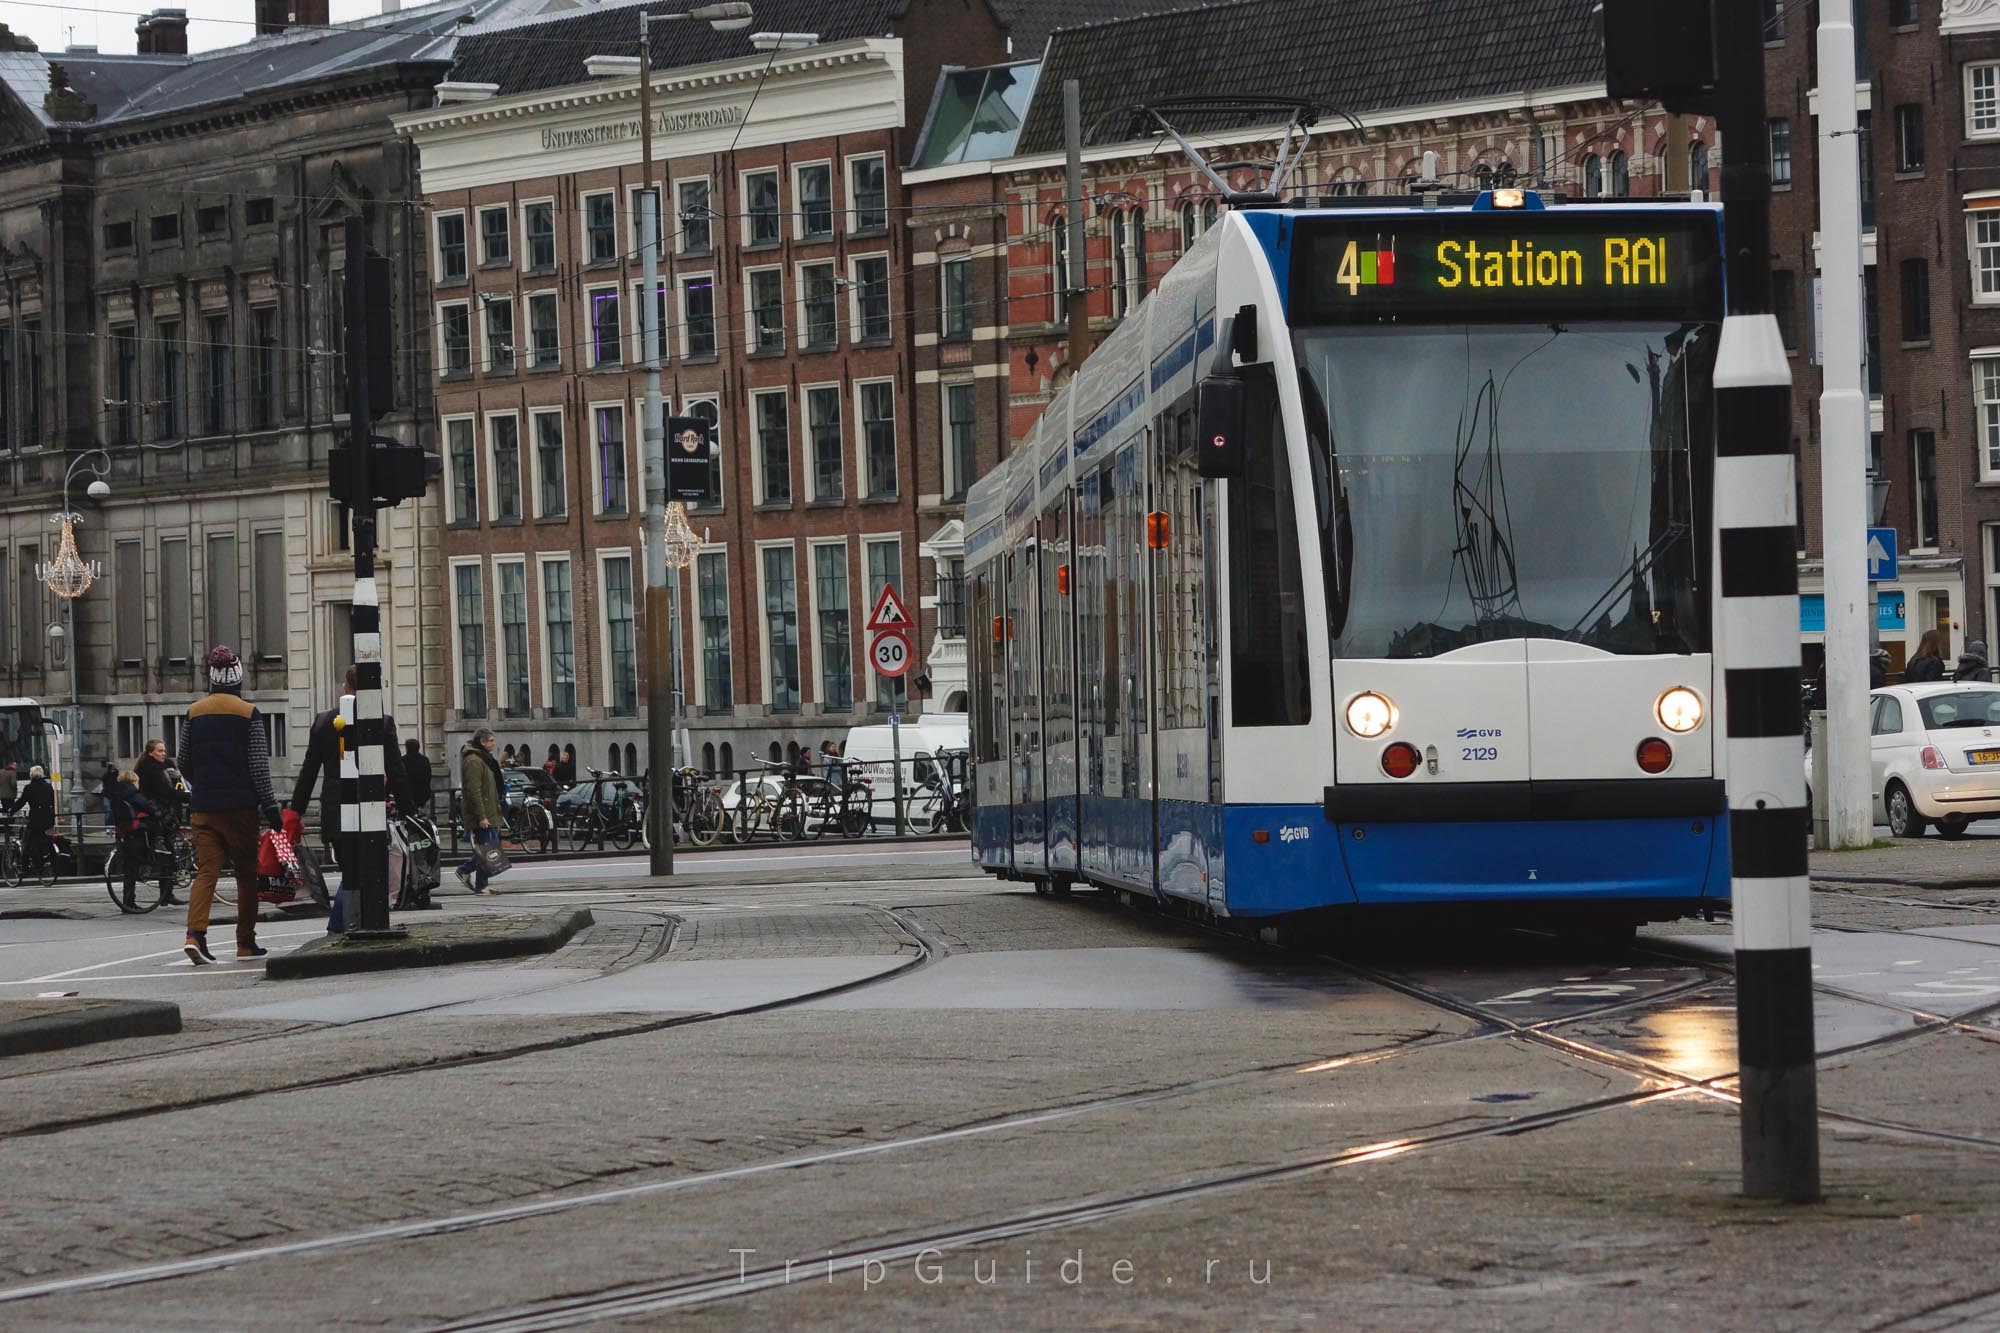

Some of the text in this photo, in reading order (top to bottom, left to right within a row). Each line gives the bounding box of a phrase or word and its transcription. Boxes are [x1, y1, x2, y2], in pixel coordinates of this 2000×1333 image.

[659, 106, 739, 132] AMSTERDAM
[1337, 237, 1666, 295] 4 Station RAI
[879, 644, 903, 663] 30
[1478, 729, 1502, 737] GVB
[1462, 747, 1498, 761] 2129
[1293, 826, 1310, 840] GVB
